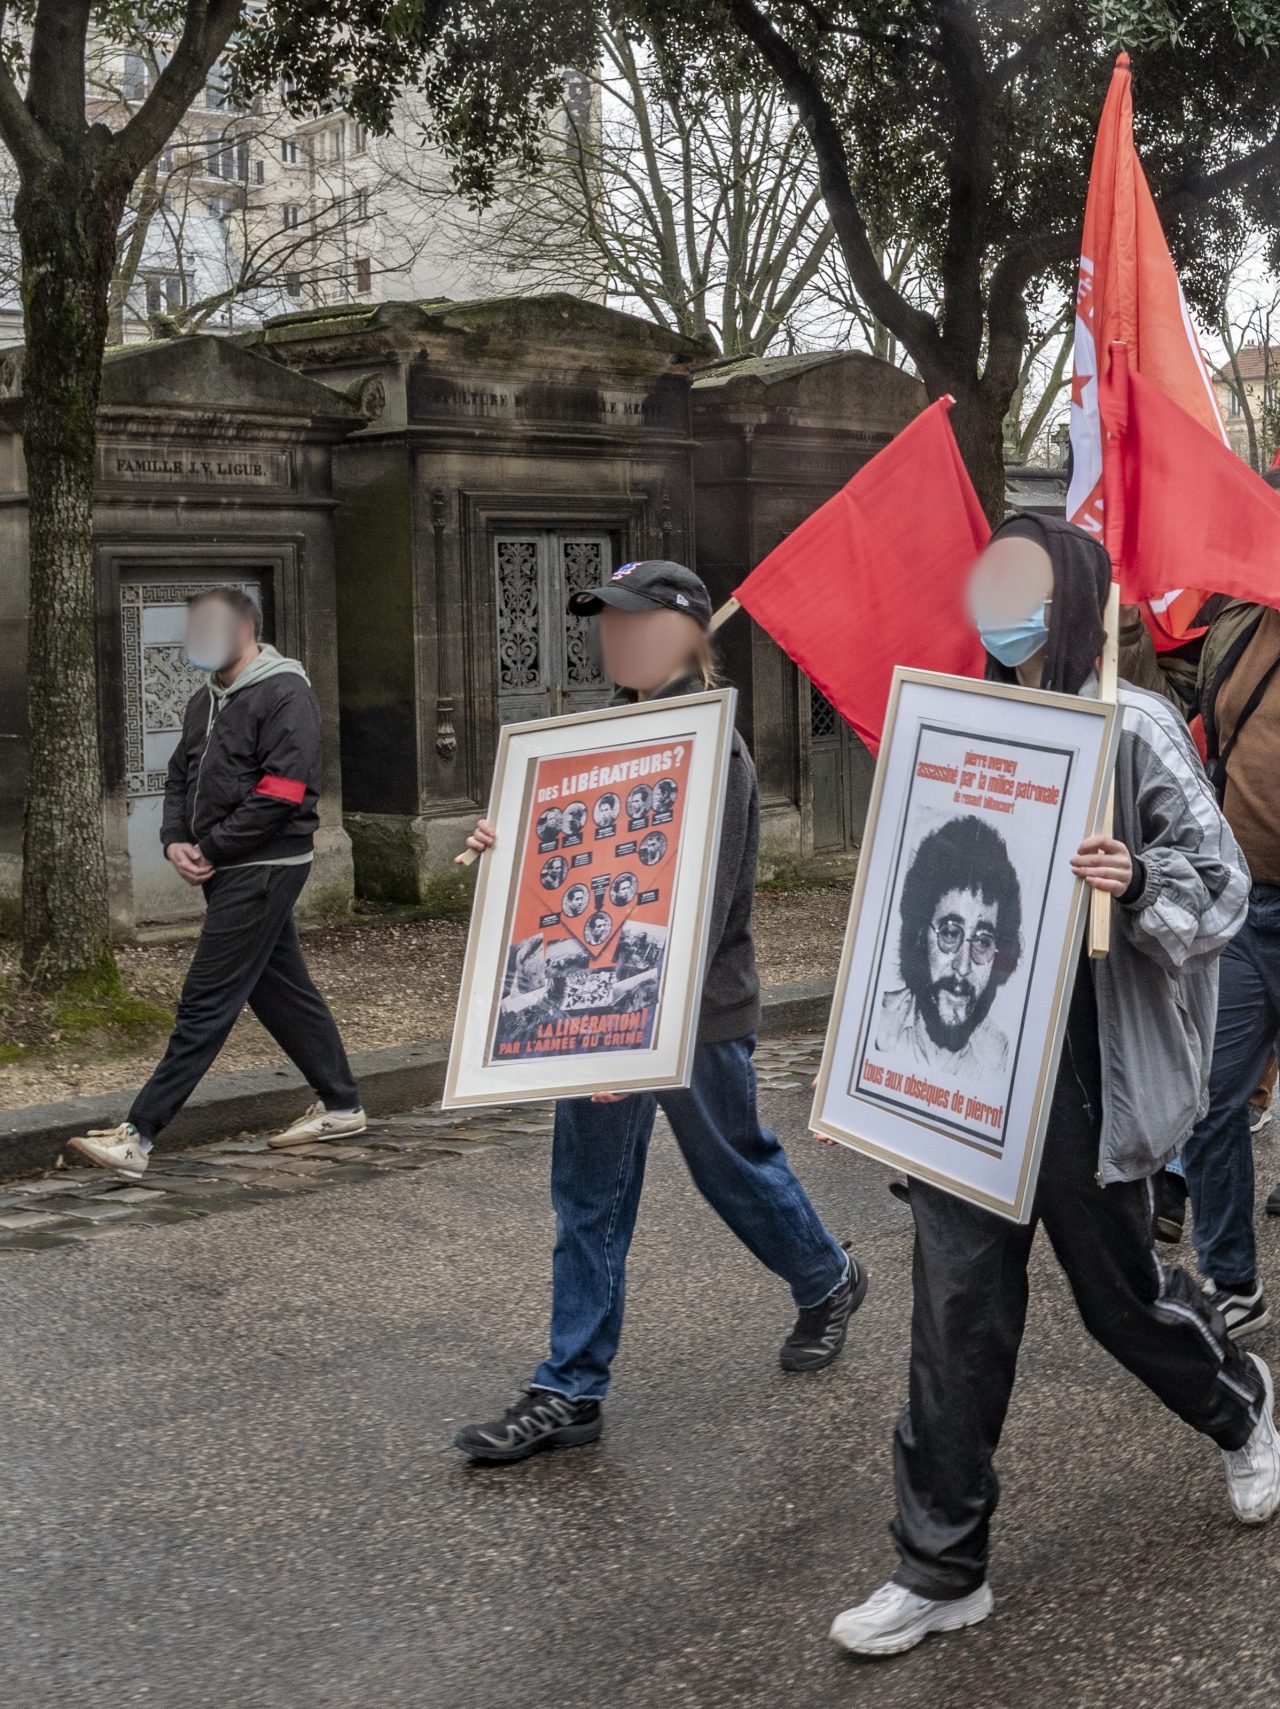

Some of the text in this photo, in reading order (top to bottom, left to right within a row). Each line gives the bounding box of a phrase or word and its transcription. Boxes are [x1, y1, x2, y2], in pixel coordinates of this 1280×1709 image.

[116, 459, 183, 474] FAMILLE
[964, 750, 1018, 777] pierre overney
[537, 785, 559, 803] DES
[917, 761, 1060, 806] assassiné par la milice patronale
[499, 1042, 520, 1055] PAR
[582, 1035, 598, 1047] DU
[604, 1031, 644, 1046] CRIME
[537, 1024, 553, 1039] LA
[863, 1058, 884, 1086] tous
[885, 1069, 904, 1093] aux
[951, 1089, 965, 1114] de
[965, 1096, 1004, 1129] pierrot
